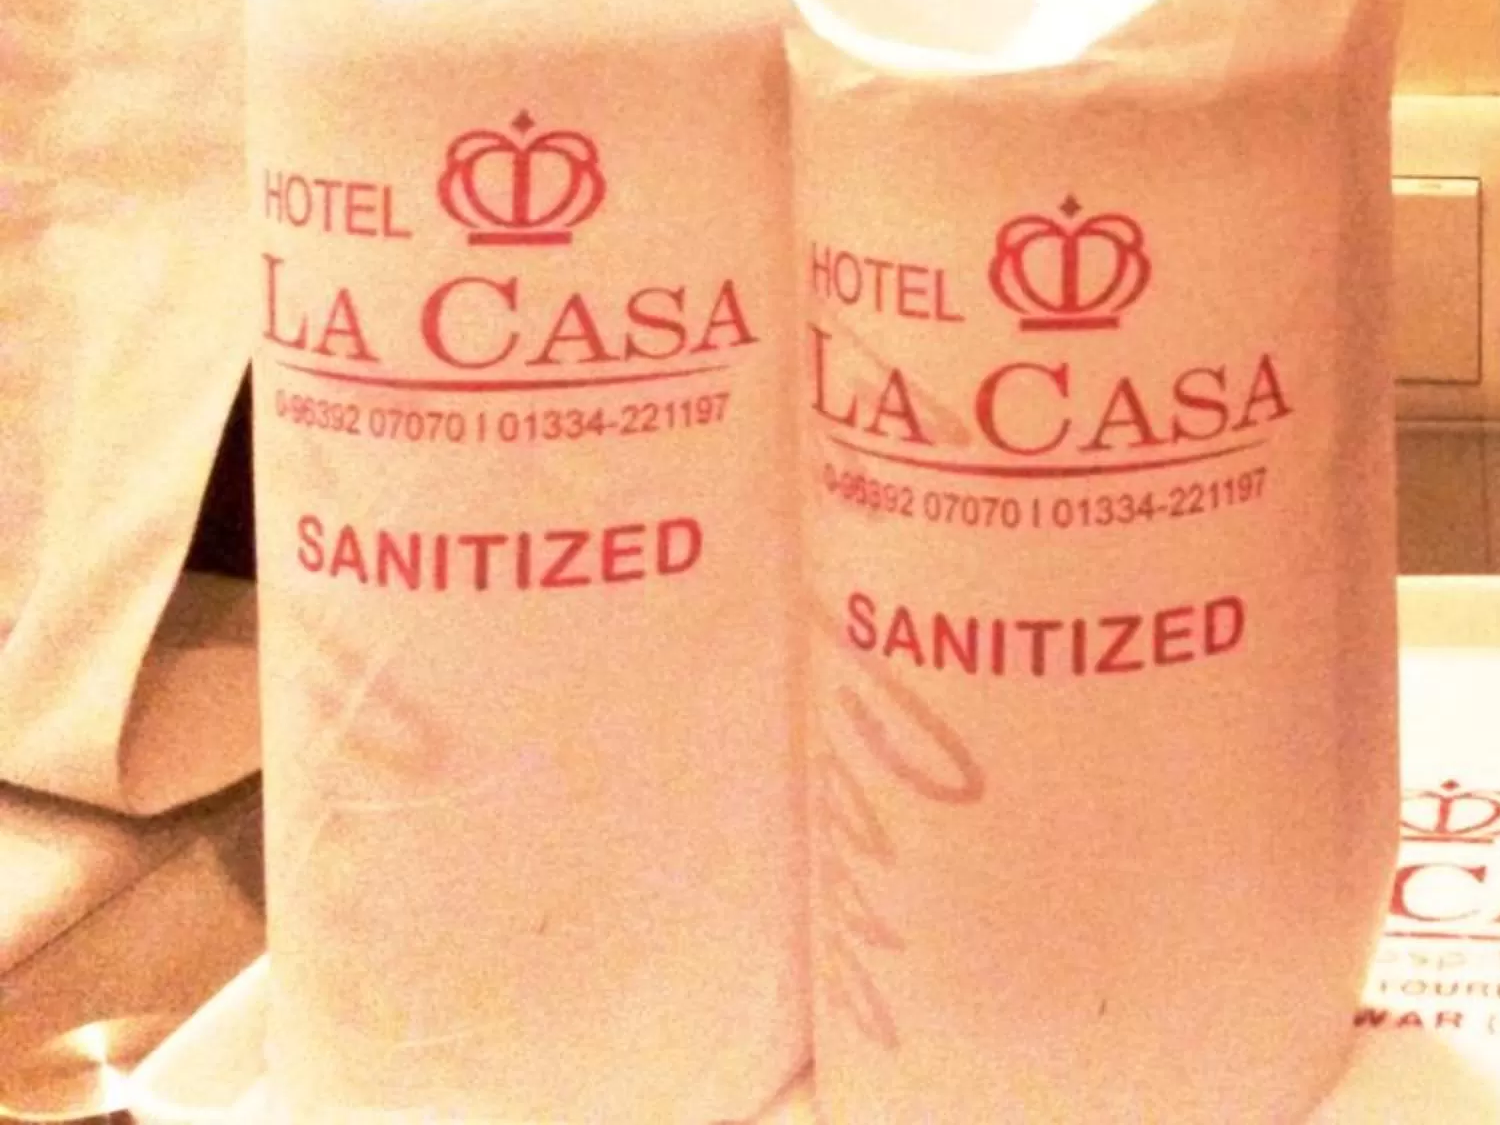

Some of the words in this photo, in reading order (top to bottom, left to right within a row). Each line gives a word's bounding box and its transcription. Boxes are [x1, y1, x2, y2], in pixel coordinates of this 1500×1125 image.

[265, 169, 412, 239] HOTEL
[262, 253, 380, 363] LA
[420, 276, 760, 370] CASA
[810, 242, 965, 322] HOTEL
[369, 407, 465, 443] 07070
[498, 392, 732, 443] 01334-221197
[808, 322, 934, 447] LA
[974, 353, 1294, 457] CASA
[923, 490, 1022, 529] 07070
[1051, 466, 1268, 529] 01334-221197
[297, 514, 704, 592] SANITIZED
[846, 591, 1246, 677] SANITIZED
